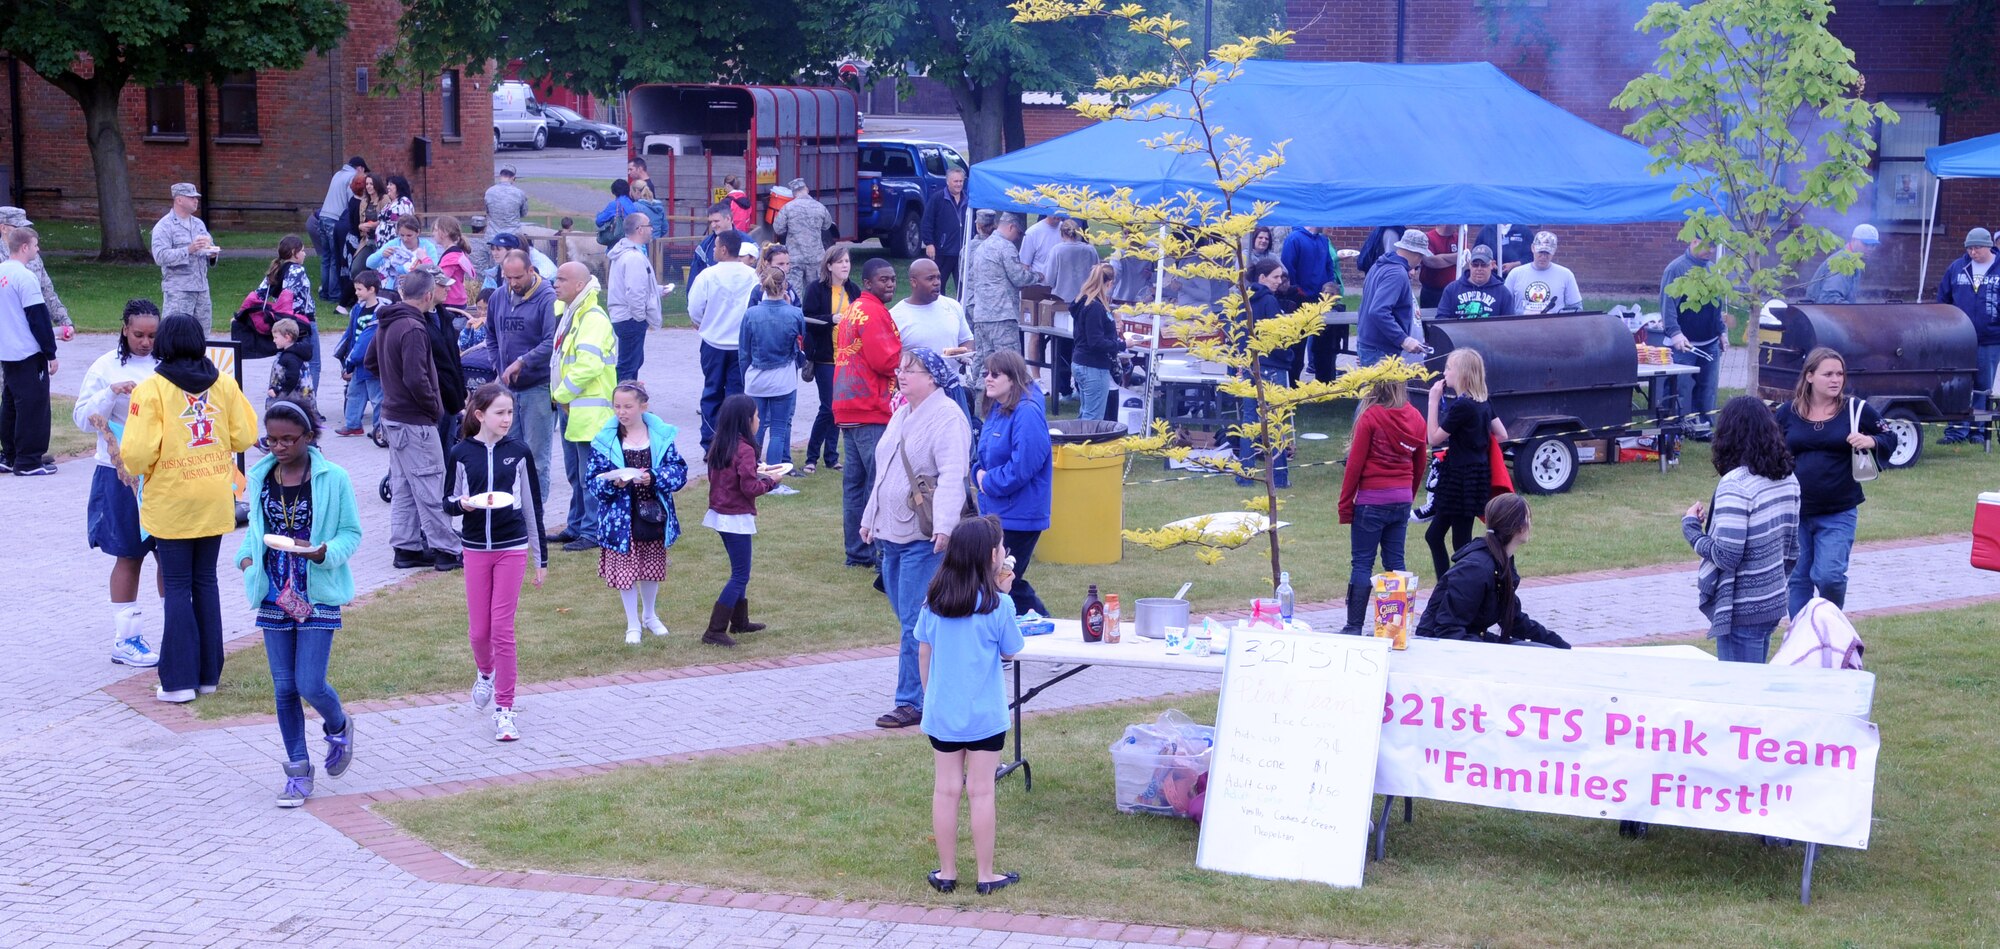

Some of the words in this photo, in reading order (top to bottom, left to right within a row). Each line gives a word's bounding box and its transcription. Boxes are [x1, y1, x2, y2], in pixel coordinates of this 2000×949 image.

[1457, 290, 1496, 307] SUPERDRY
[161, 457, 187, 470] RISING
[1239, 639, 1296, 667] 321
[1308, 641, 1379, 677] STS
[1232, 675, 1295, 705] Pink
[1272, 712, 1295, 727] Ice
[1382, 691, 1488, 734] 321st
[1505, 703, 1584, 743] STS
[1604, 711, 1708, 757] Pink
[1728, 724, 1858, 770] Team
[1258, 758, 1287, 770] cone
[1225, 773, 1253, 790] Adult
[1256, 780, 1278, 794] cup
[1424, 747, 1629, 803] "Families
[1649, 772, 1793, 817] First!"
